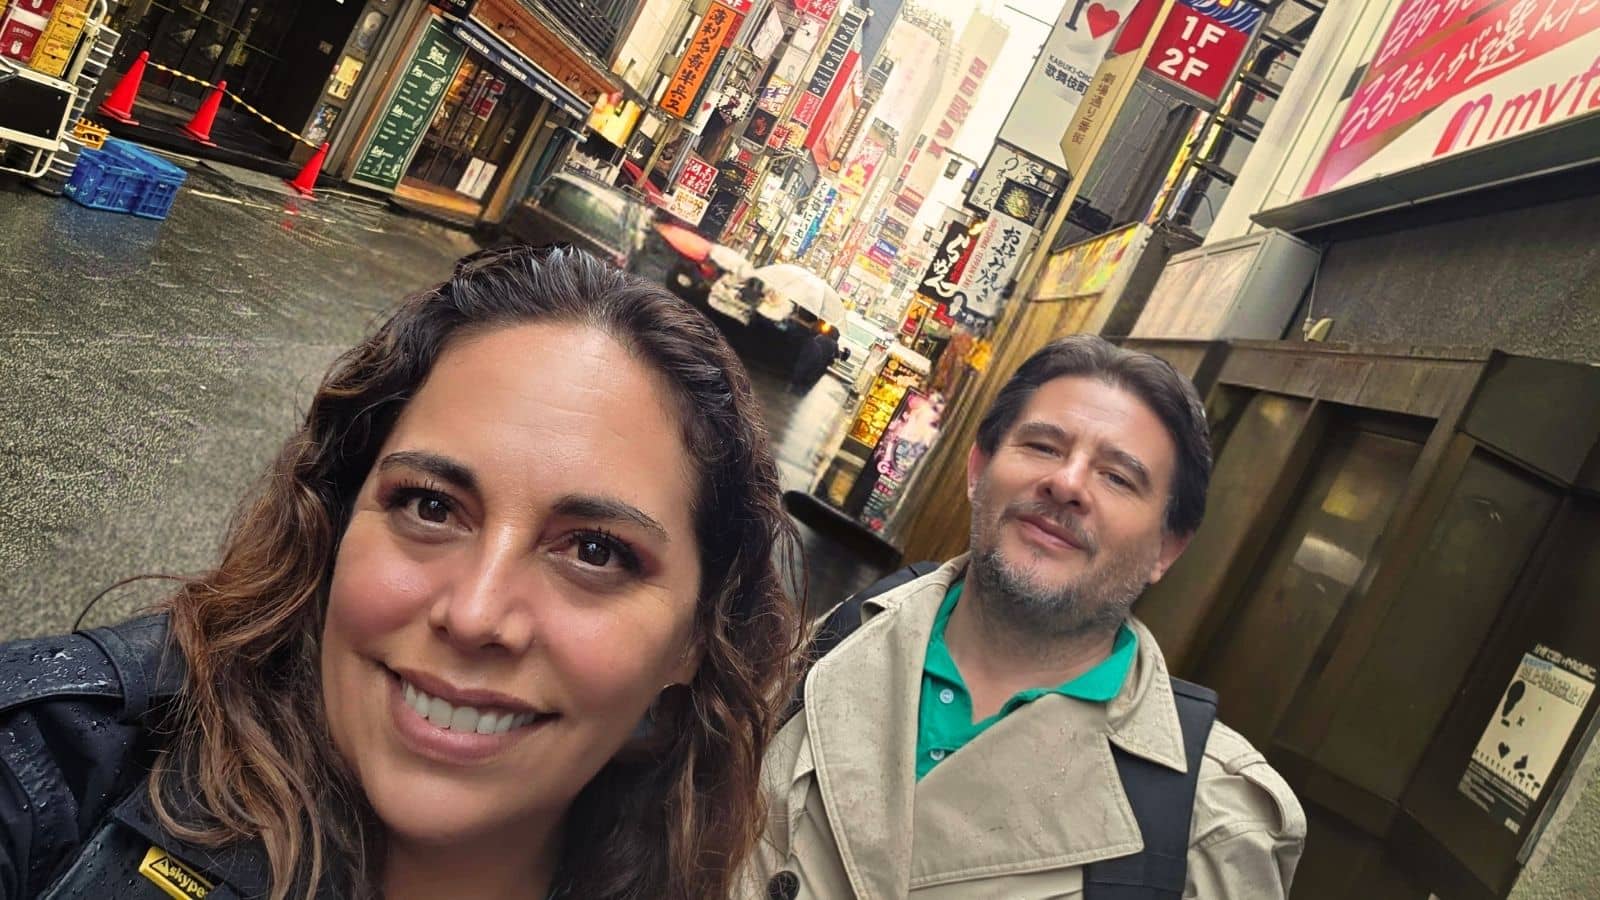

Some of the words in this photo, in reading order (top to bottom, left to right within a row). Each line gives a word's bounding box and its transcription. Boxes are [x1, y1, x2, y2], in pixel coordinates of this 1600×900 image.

[1182, 15, 1227, 49] 1F
[1045, 62, 1090, 97] 歌舞伎町
[1158, 48, 1209, 82] 2F
[1072, 72, 1117, 145] 劇場通り一番街
